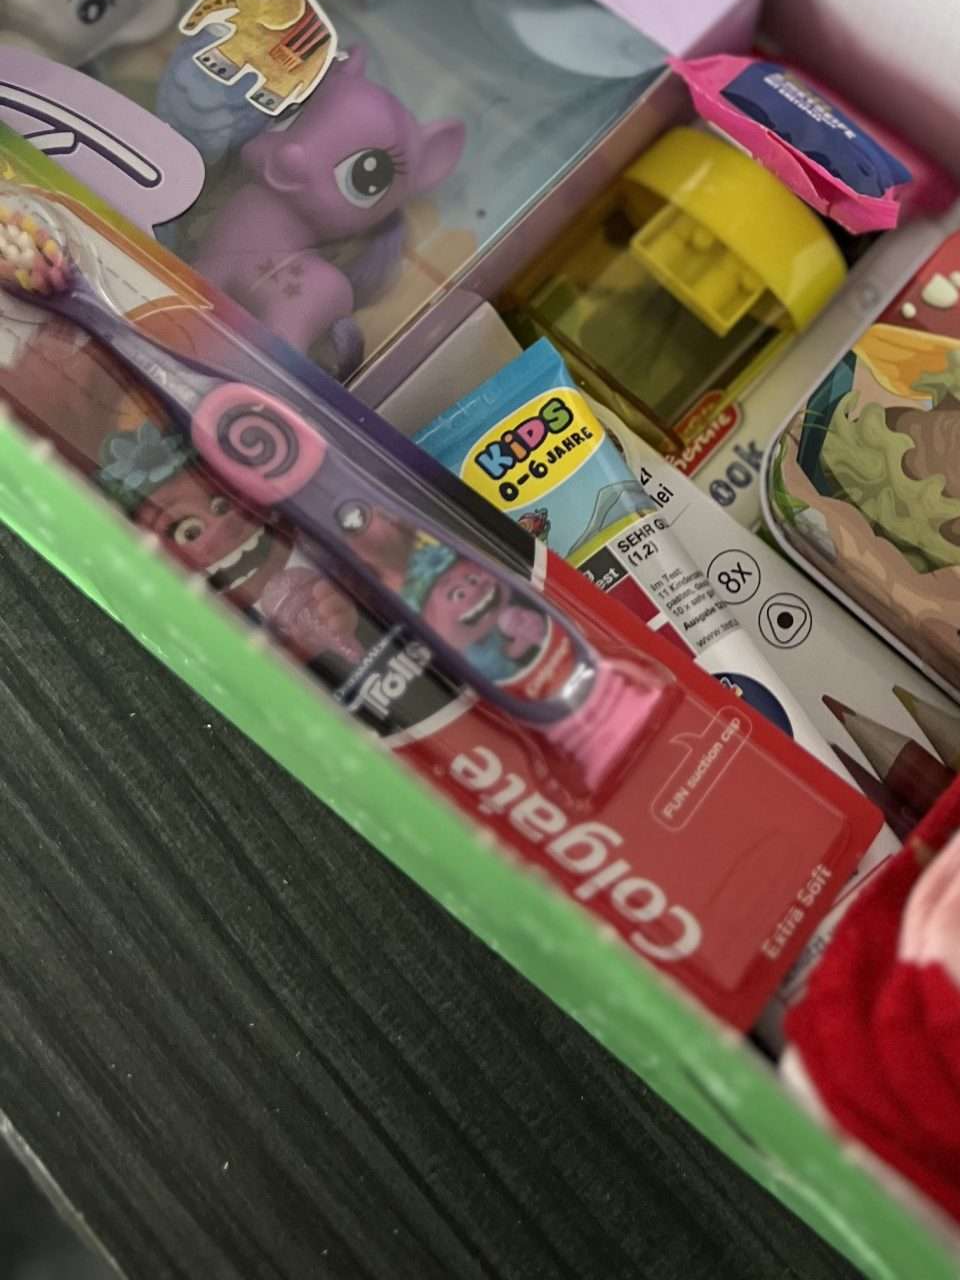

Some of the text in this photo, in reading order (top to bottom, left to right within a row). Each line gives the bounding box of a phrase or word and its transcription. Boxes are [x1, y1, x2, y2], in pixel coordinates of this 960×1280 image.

[544, 425, 593, 465] JAHRE
[616, 521, 655, 554] SEHR
[716, 561, 752, 596] 8x
[661, 786, 691, 819] FUN
[684, 739, 724, 789] suction
[444, 742, 703, 960] Colgate
[758, 904, 807, 962] Extra
[793, 860, 834, 908] Soft
